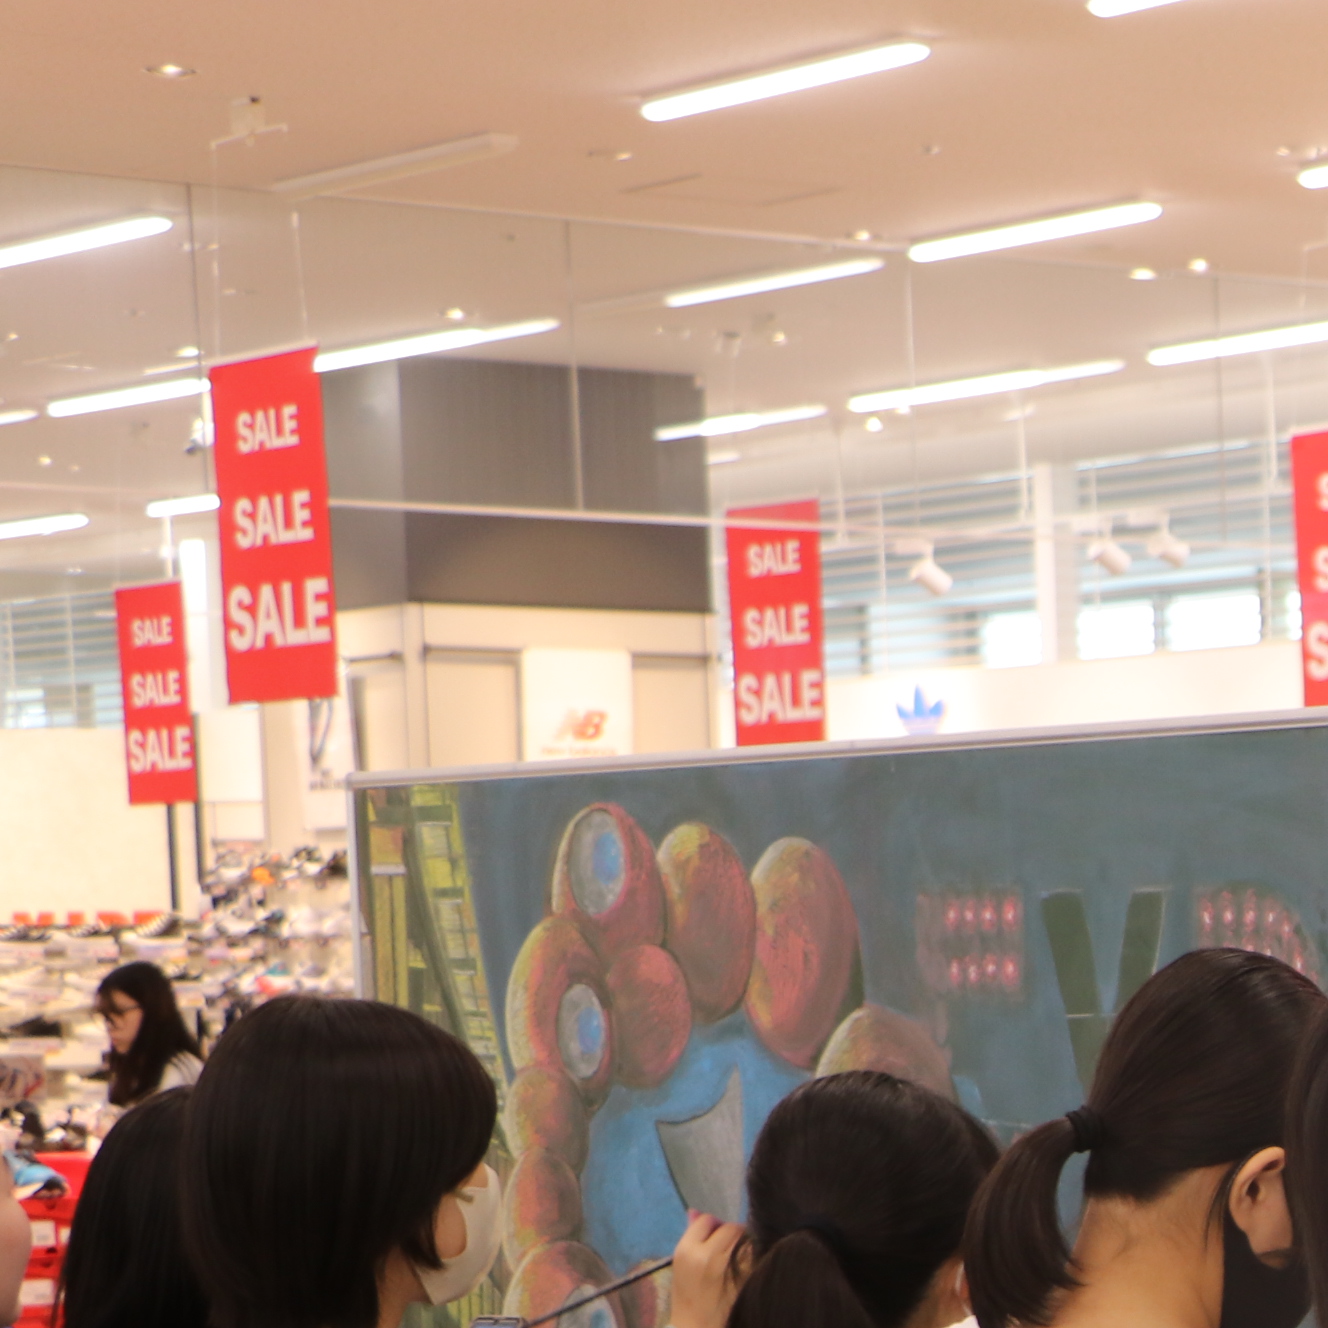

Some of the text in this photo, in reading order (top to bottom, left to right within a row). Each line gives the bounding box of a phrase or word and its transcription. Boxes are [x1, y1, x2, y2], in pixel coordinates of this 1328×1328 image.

[236, 404, 299, 454] SALE
[233, 489, 314, 549] SALE
[746, 540, 800, 577] SALE
[131, 616, 172, 646] SALE
[228, 577, 332, 654] SALE
[743, 603, 810, 649] SALE
[130, 670, 181, 707] SALE
[737, 669, 824, 726] SALE
[128, 726, 192, 772] SALE
